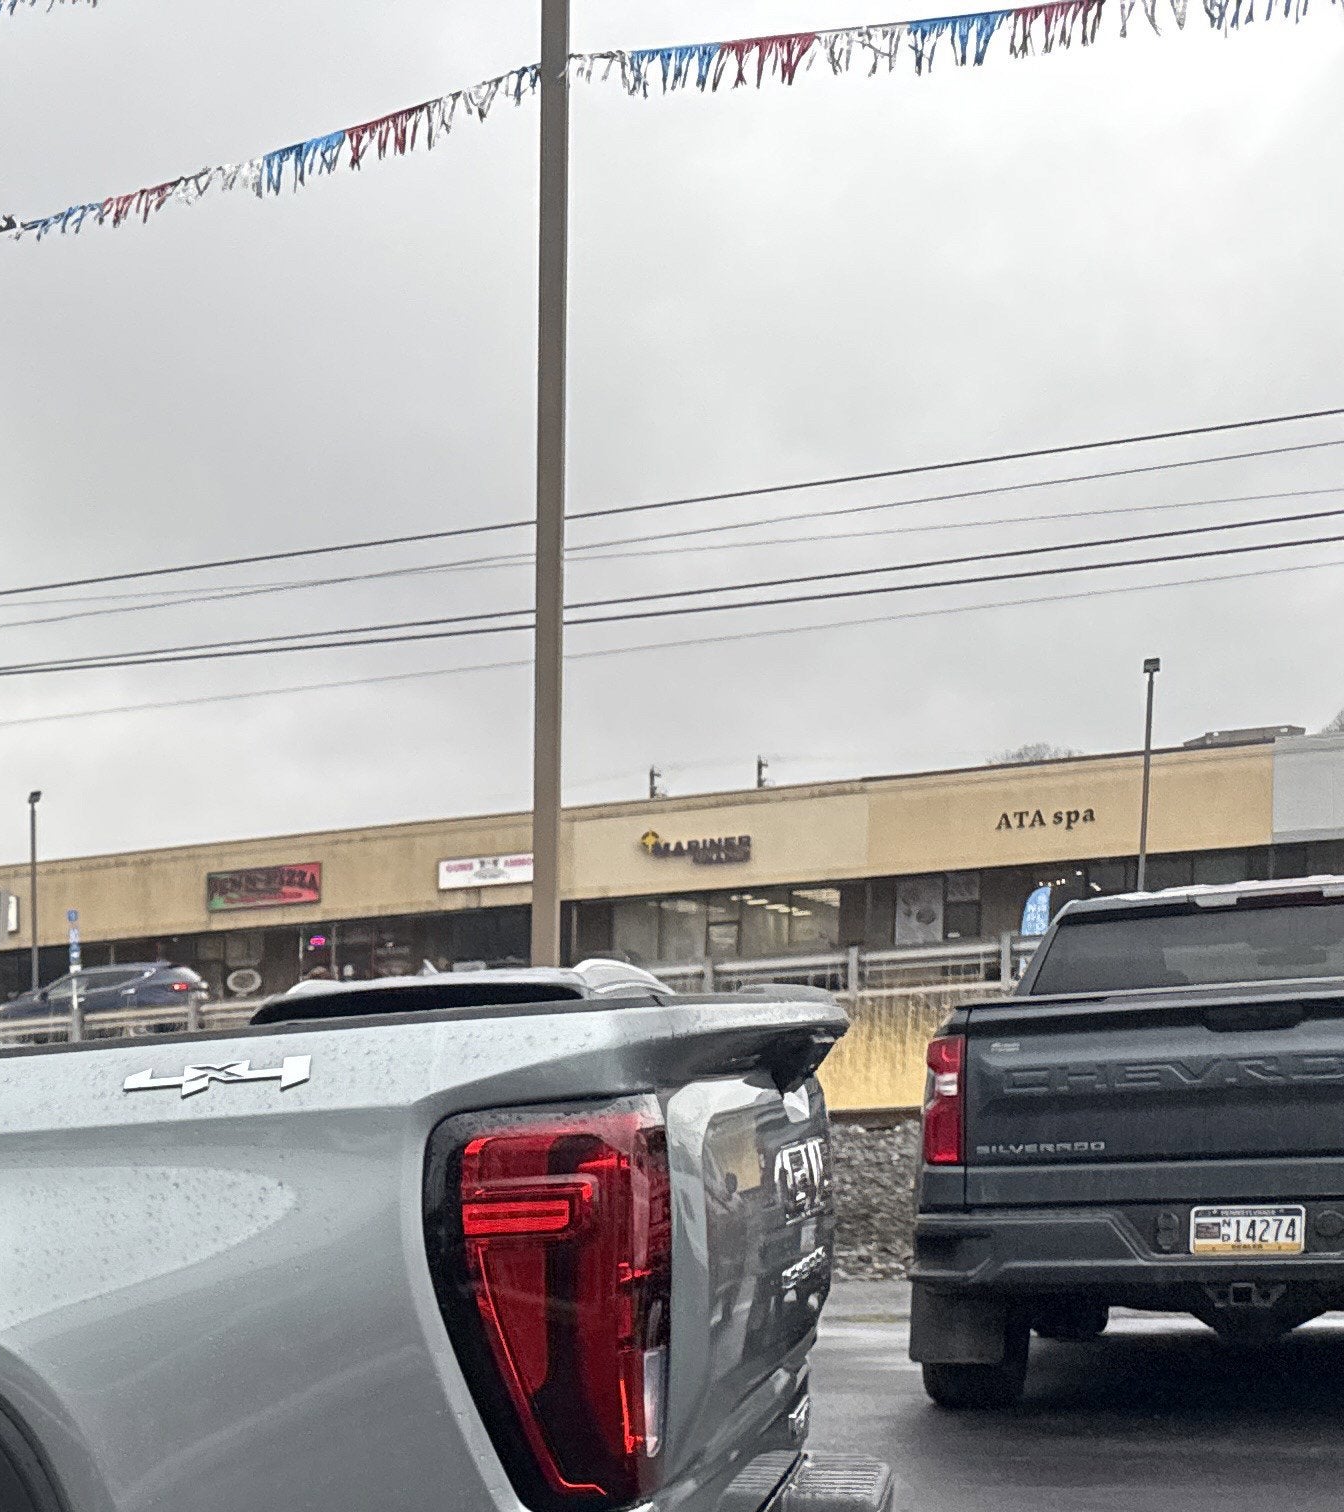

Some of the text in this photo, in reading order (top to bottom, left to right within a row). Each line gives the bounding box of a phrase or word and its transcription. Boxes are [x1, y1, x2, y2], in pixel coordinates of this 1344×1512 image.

[995, 808, 1096, 831] ATA spa
[650, 835, 750, 858] MARINER
[976, 1141, 1106, 1154] SILVERADO
[1234, 1218, 1296, 1242] 14274
